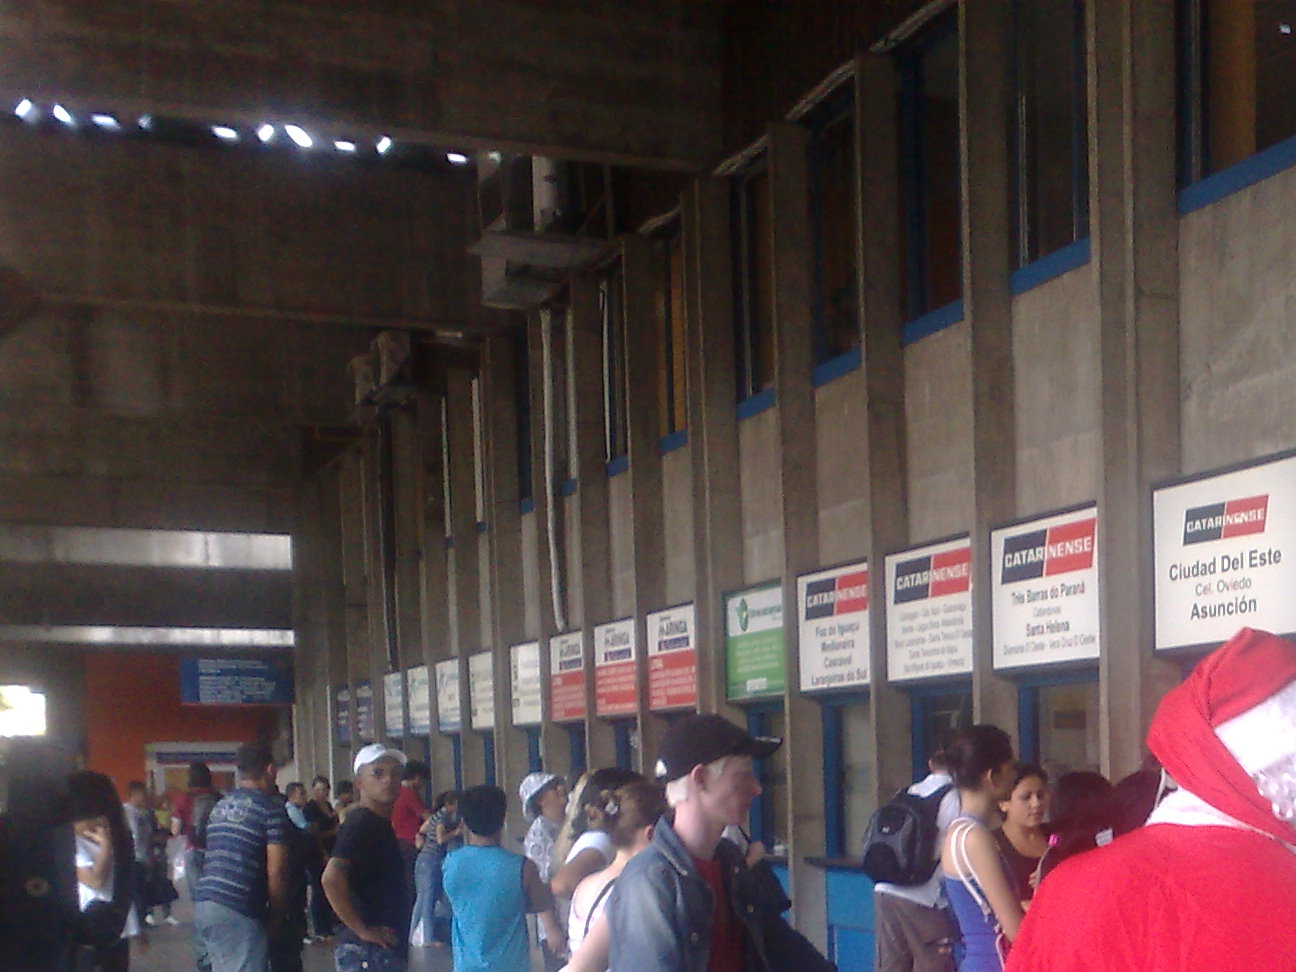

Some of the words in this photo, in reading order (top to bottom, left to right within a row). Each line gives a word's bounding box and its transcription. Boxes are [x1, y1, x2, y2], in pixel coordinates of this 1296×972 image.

[1186, 507, 1265, 533] CATARINENSE
[1005, 536, 1092, 568] CATARINENSE
[1169, 557, 1216, 581] Ciudad
[1221, 552, 1244, 572] Del
[1249, 547, 1282, 568] Este
[896, 563, 969, 590] CATARINENSE
[1216, 577, 1252, 593] Oviedo
[1190, 595, 1257, 621] Asunción
